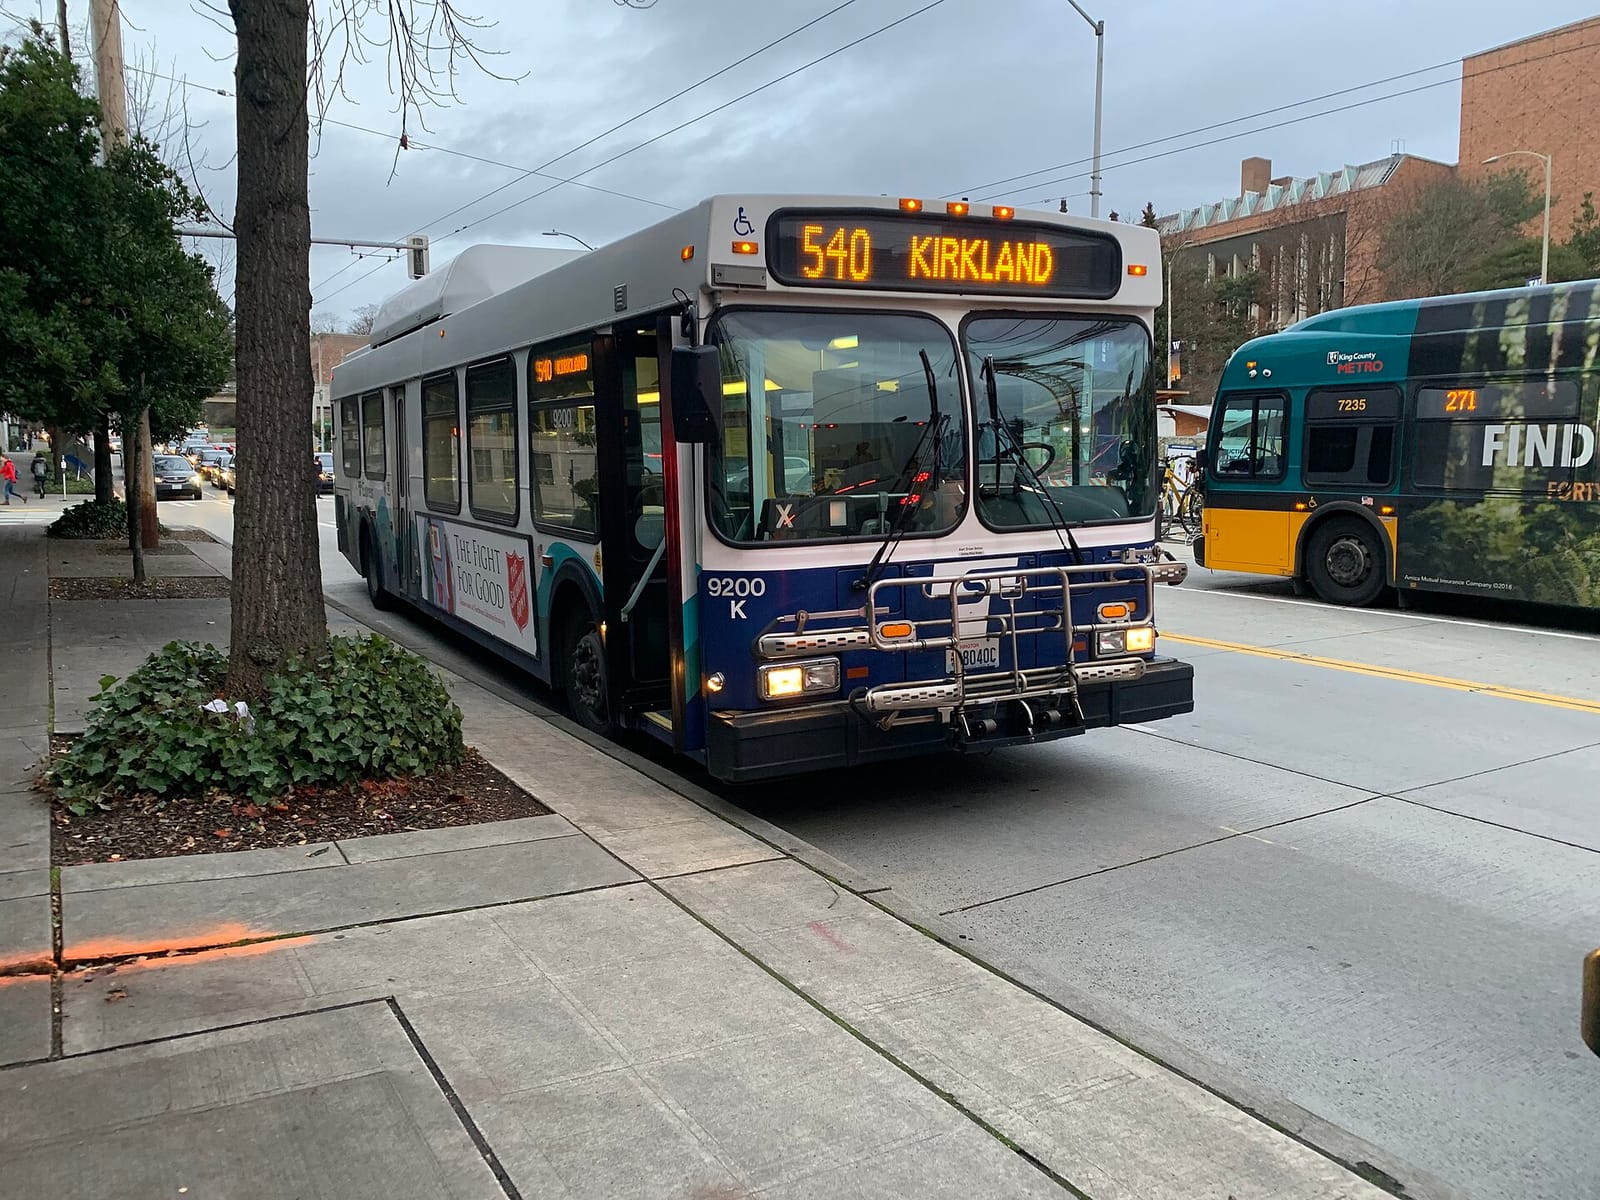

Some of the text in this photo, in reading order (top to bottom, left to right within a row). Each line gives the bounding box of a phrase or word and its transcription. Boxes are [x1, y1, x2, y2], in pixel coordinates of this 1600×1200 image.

[803, 225, 1052, 283] 540 KIRKLAND
[1172, 340, 1181, 350] W
[1339, 352, 1376, 362] King County
[1337, 360, 1383, 375] METRO
[1337, 398, 1367, 411] 7235
[1445, 389, 1476, 411] 271
[553, 408, 572, 428] 9200
[1482, 423, 1595, 468] FIND
[454, 534, 500, 575] THE FIGHT
[457, 565, 475, 597] FOR
[475, 572, 505, 609] GOOD
[707, 577, 766, 597] 9200
[1421, 575, 1439, 584] Mutual
[1439, 578, 1465, 586] Insurance
[1465, 579, 1492, 589] Company
[730, 600, 748, 619] K
